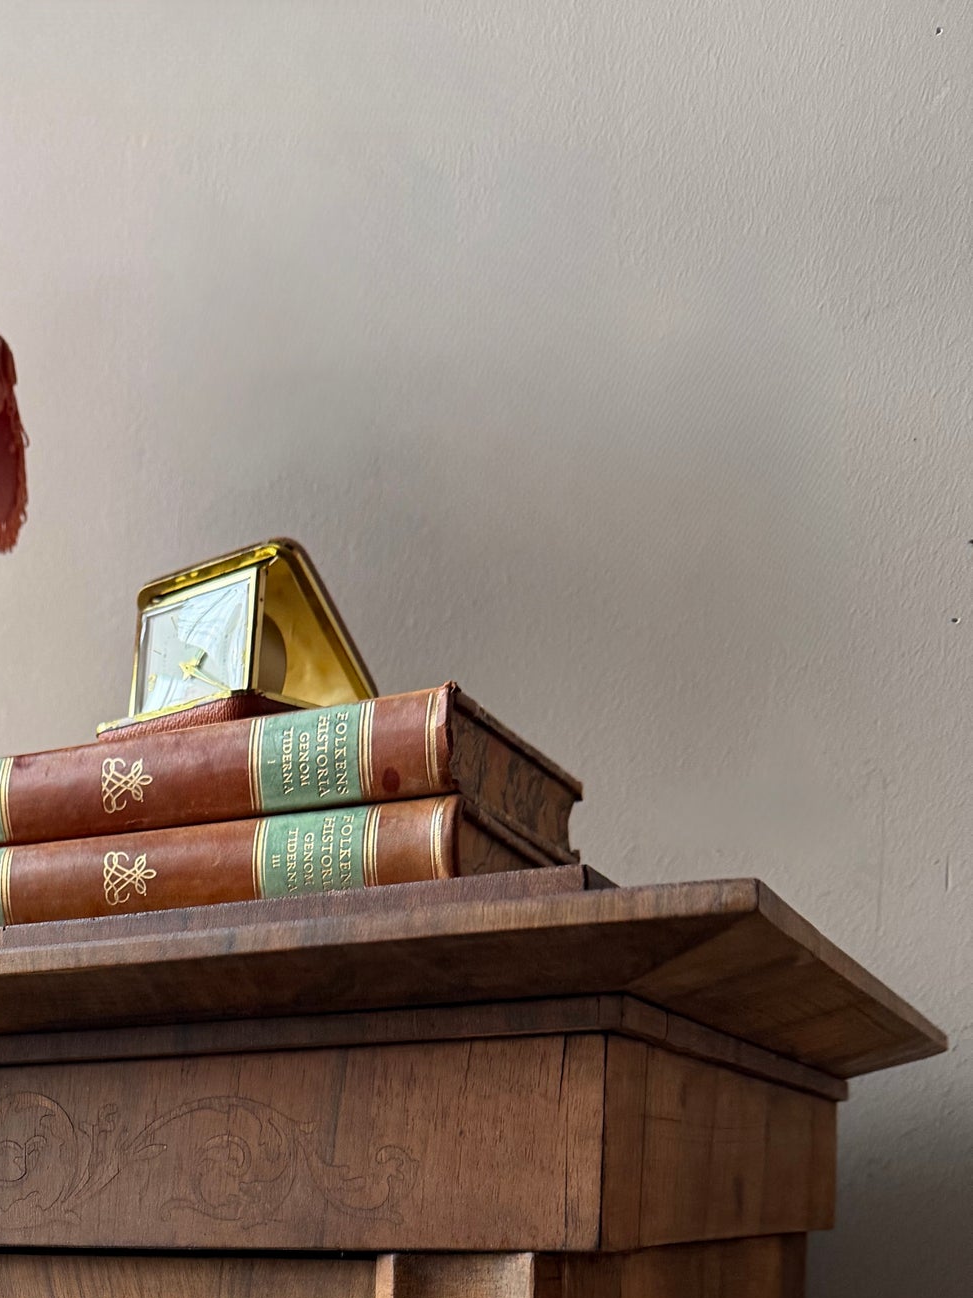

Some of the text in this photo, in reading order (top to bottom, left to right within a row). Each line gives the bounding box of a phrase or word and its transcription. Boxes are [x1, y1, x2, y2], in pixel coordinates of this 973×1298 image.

[282, 726, 294, 795] TIDERNA
[298, 731, 310, 787] GENOM
[316, 713, 331, 797] HISTORIA
[335, 711, 349, 795] FOLKENS
[272, 854, 281, 868] III
[287, 827, 298, 893] TIDERNA
[303, 832, 315, 886] GENOM
